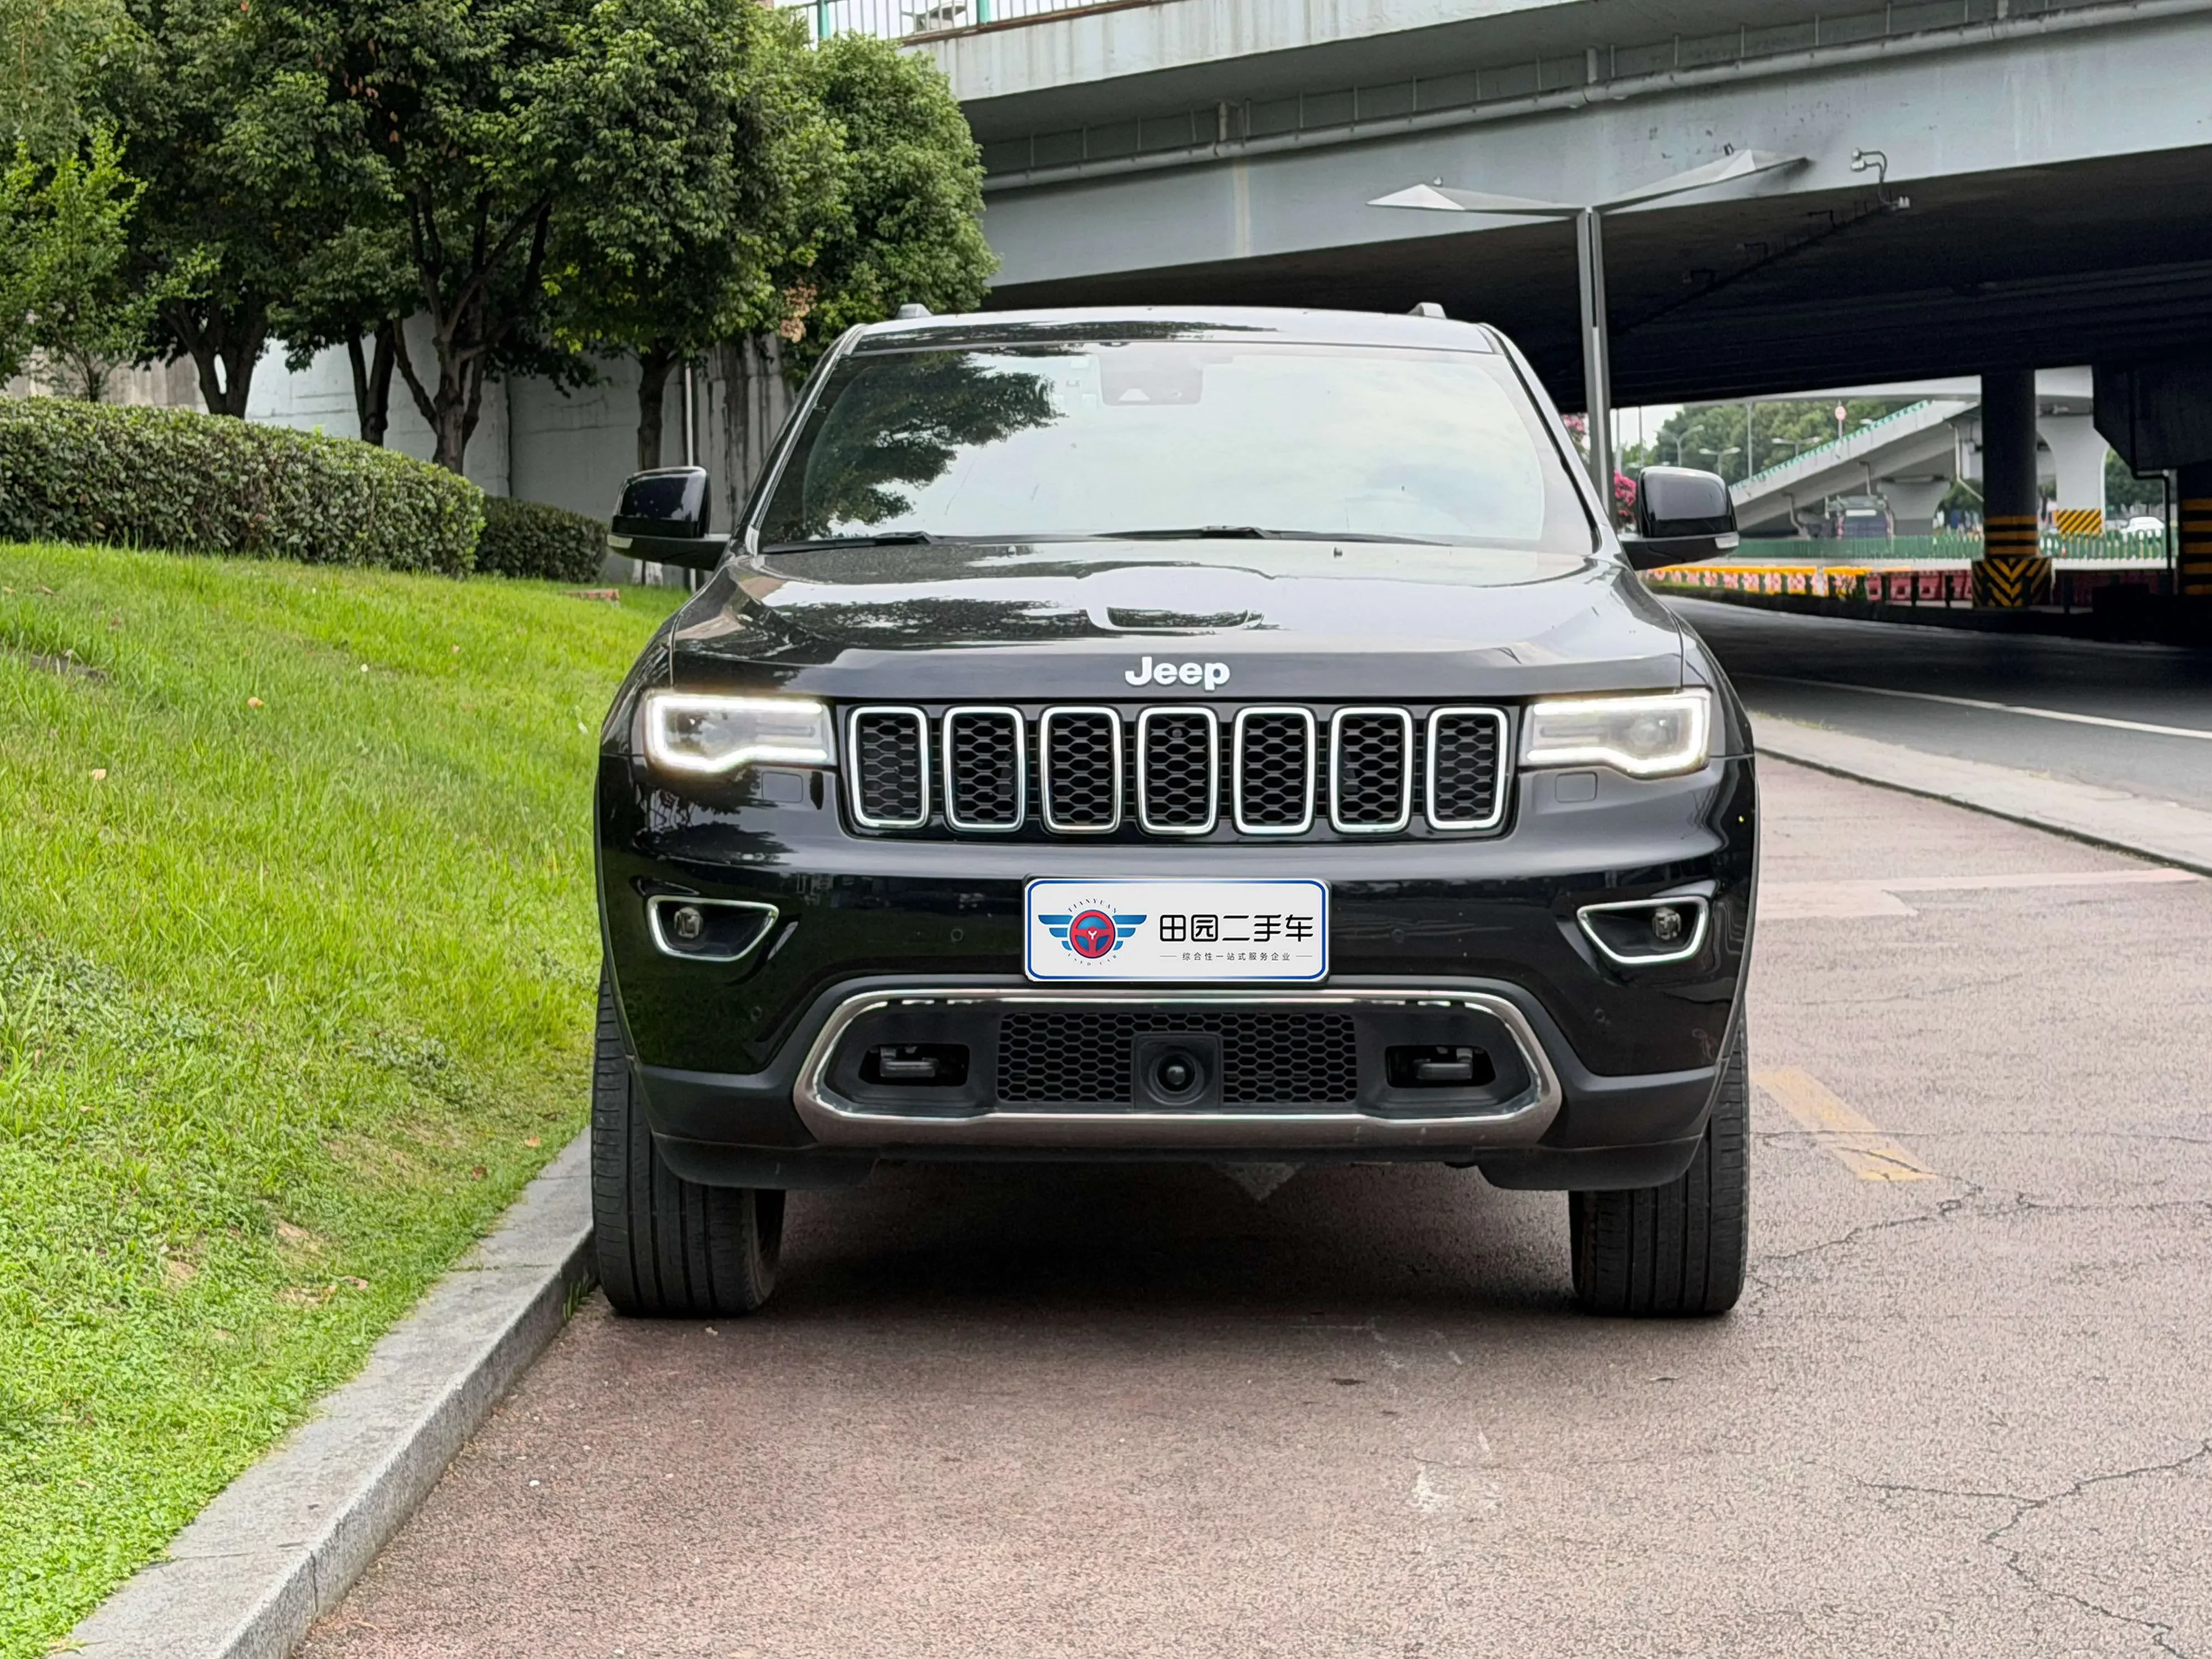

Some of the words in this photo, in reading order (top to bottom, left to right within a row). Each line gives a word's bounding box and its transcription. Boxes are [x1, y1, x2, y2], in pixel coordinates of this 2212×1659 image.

[1125, 656, 1230, 690] Jeep
[1159, 914, 1313, 942] 田园二手车
[1182, 952, 1291, 961] 综合性一站式服务企业
